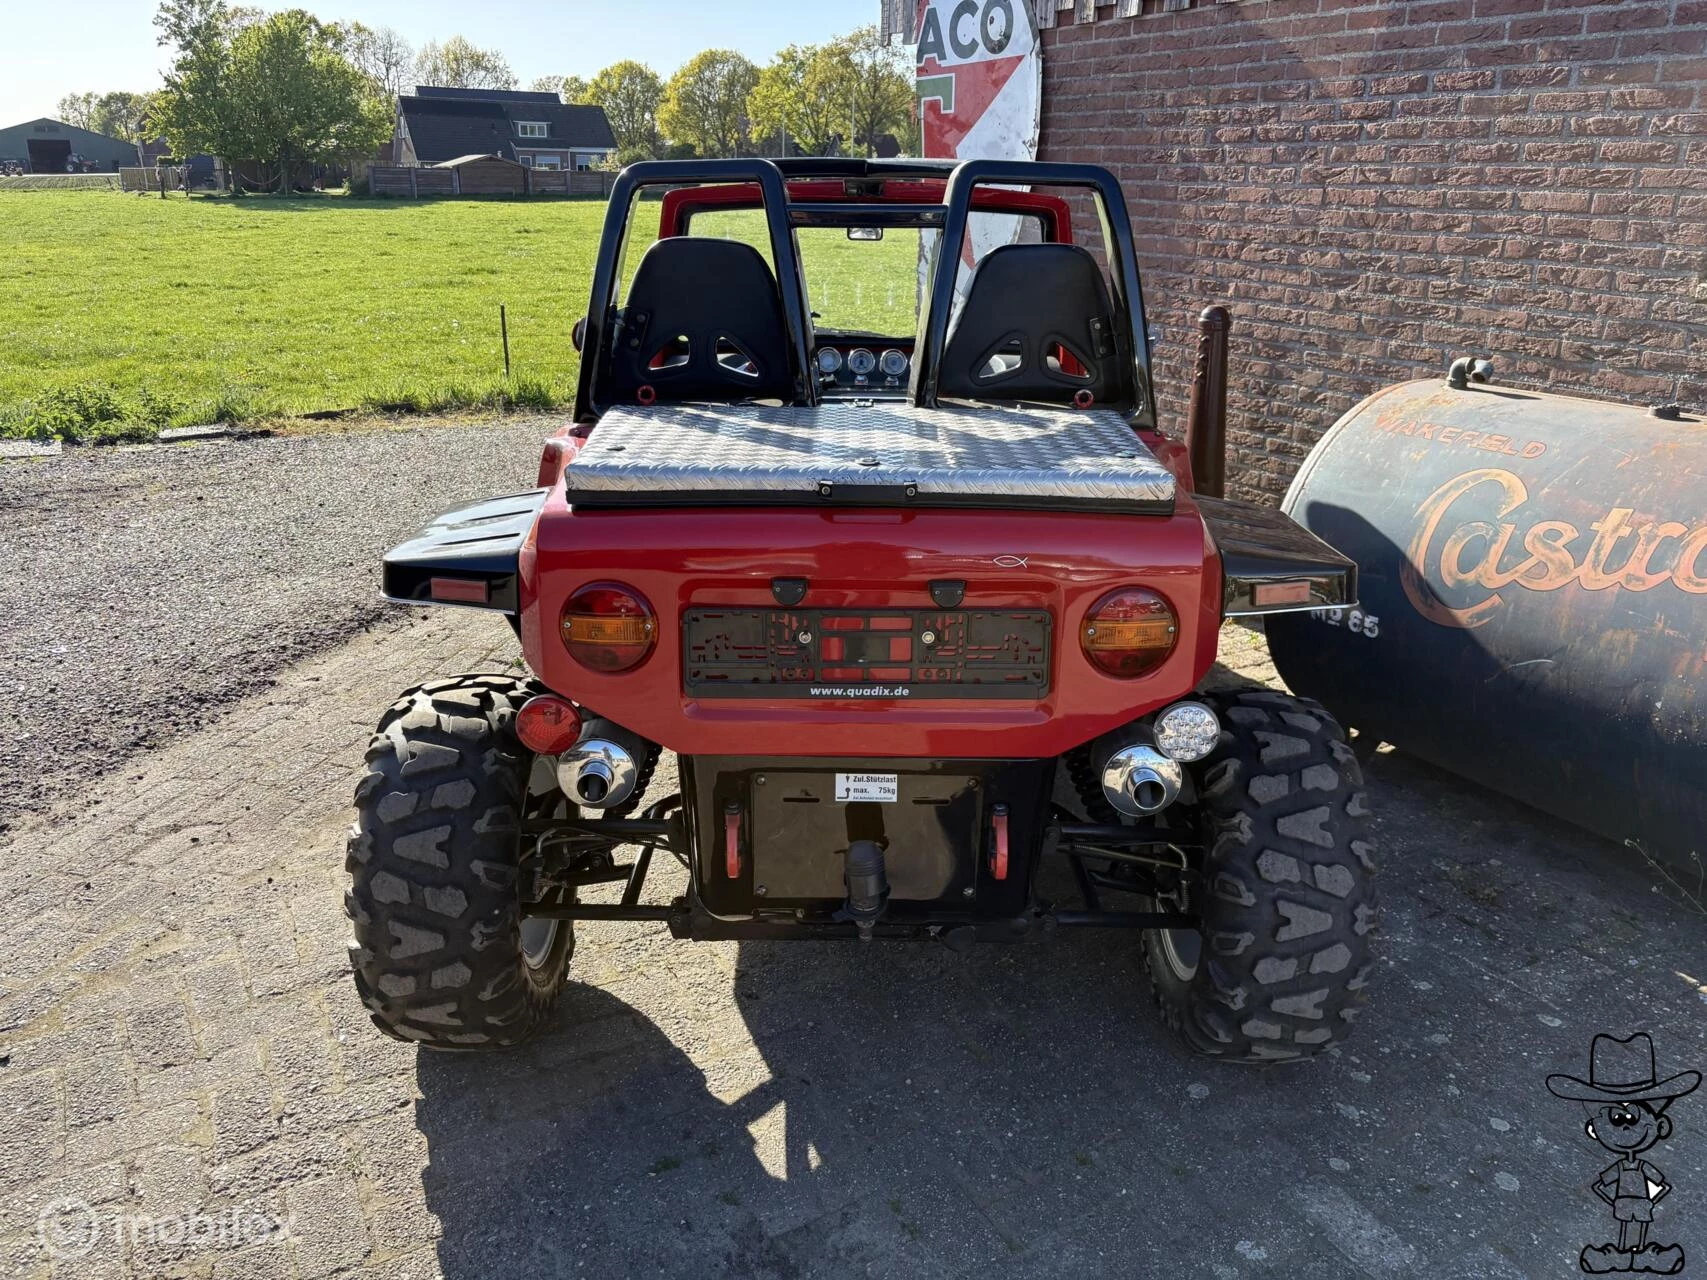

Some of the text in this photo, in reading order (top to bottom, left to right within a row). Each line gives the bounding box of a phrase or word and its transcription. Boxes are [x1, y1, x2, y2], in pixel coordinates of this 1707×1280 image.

[917, 0, 1014, 64] ACO
[1376, 415, 1548, 460] WAKEFIELD
[1347, 610, 1379, 638] 65
[810, 686, 909, 697] www.quadix.de
[878, 786, 896, 795] 75kg
